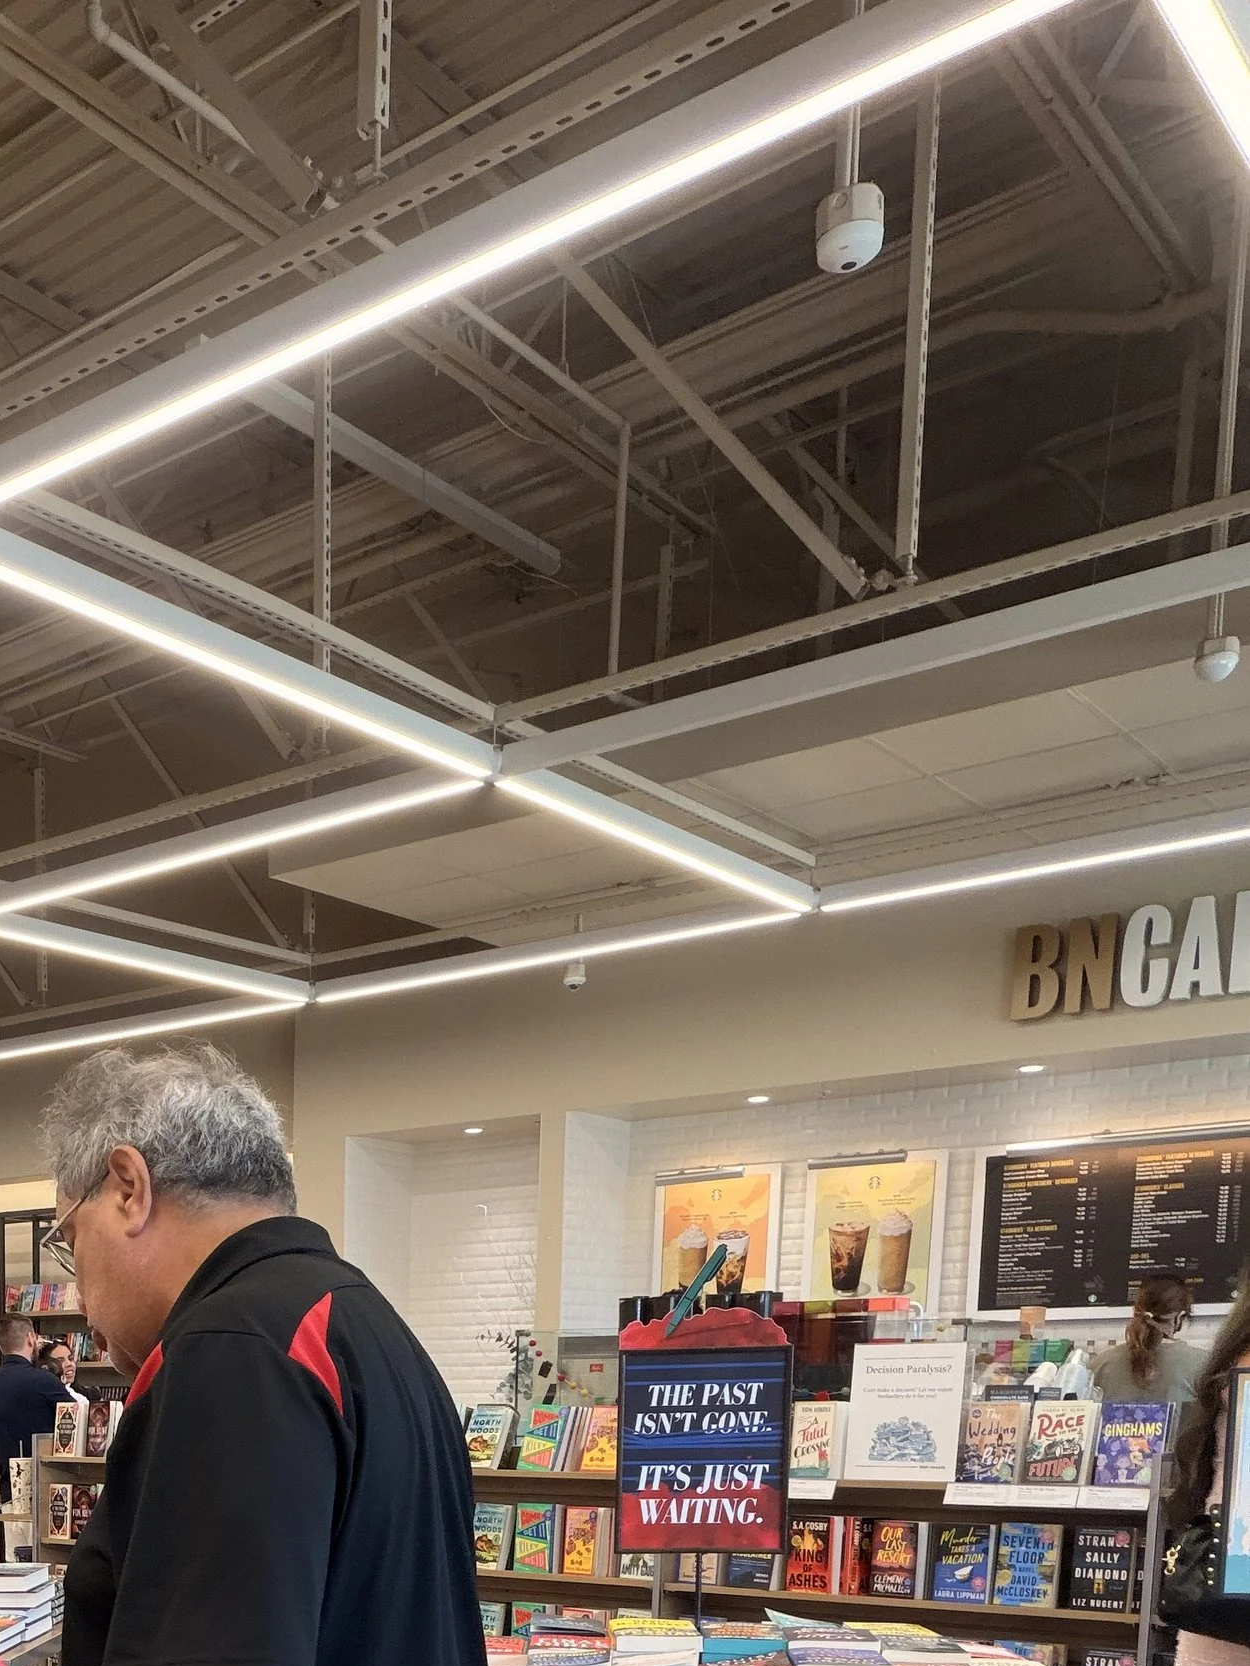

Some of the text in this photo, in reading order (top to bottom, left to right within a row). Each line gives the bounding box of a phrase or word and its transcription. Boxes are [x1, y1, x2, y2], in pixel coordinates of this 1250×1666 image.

[866, 1365, 952, 1375] Decision Paralysis?
[648, 1382, 764, 1407] THE PAST
[633, 1411, 772, 1435] ISN'T GONE.
[1037, 1413, 1086, 1440] RACE
[1104, 1421, 1163, 1438] GINGHAMS
[798, 1421, 828, 1444] Fatal
[969, 1422, 1017, 1440] Wedding
[637, 1464, 769, 1495] IT'S JUST
[639, 1497, 764, 1525] WAITING.
[474, 1525, 502, 1533] WOODS
[524, 1525, 546, 1540] GET IT
[805, 1521, 828, 1531] COSBY
[881, 1526, 902, 1542] OUR
[940, 1528, 981, 1547] Murder
[885, 1538, 907, 1552] LAST
[794, 1549, 823, 1563] KING
[877, 1550, 912, 1565] RESORT
[942, 1553, 984, 1565] VACATION
[1009, 1551, 1045, 1564] FLOOR
[1086, 1552, 1121, 1563] SALLY
[621, 1564, 639, 1575] AMITY
[803, 1564, 813, 1572] OF
[1075, 1568, 1128, 1580] DIAMOND
[788, 1575, 827, 1588] ASHES
[1011, 1575, 1037, 1585] DAVID
[934, 1589, 985, 1601] LAURA LIPPMAN
[1072, 1598, 1125, 1609] LIZ NUGENT
